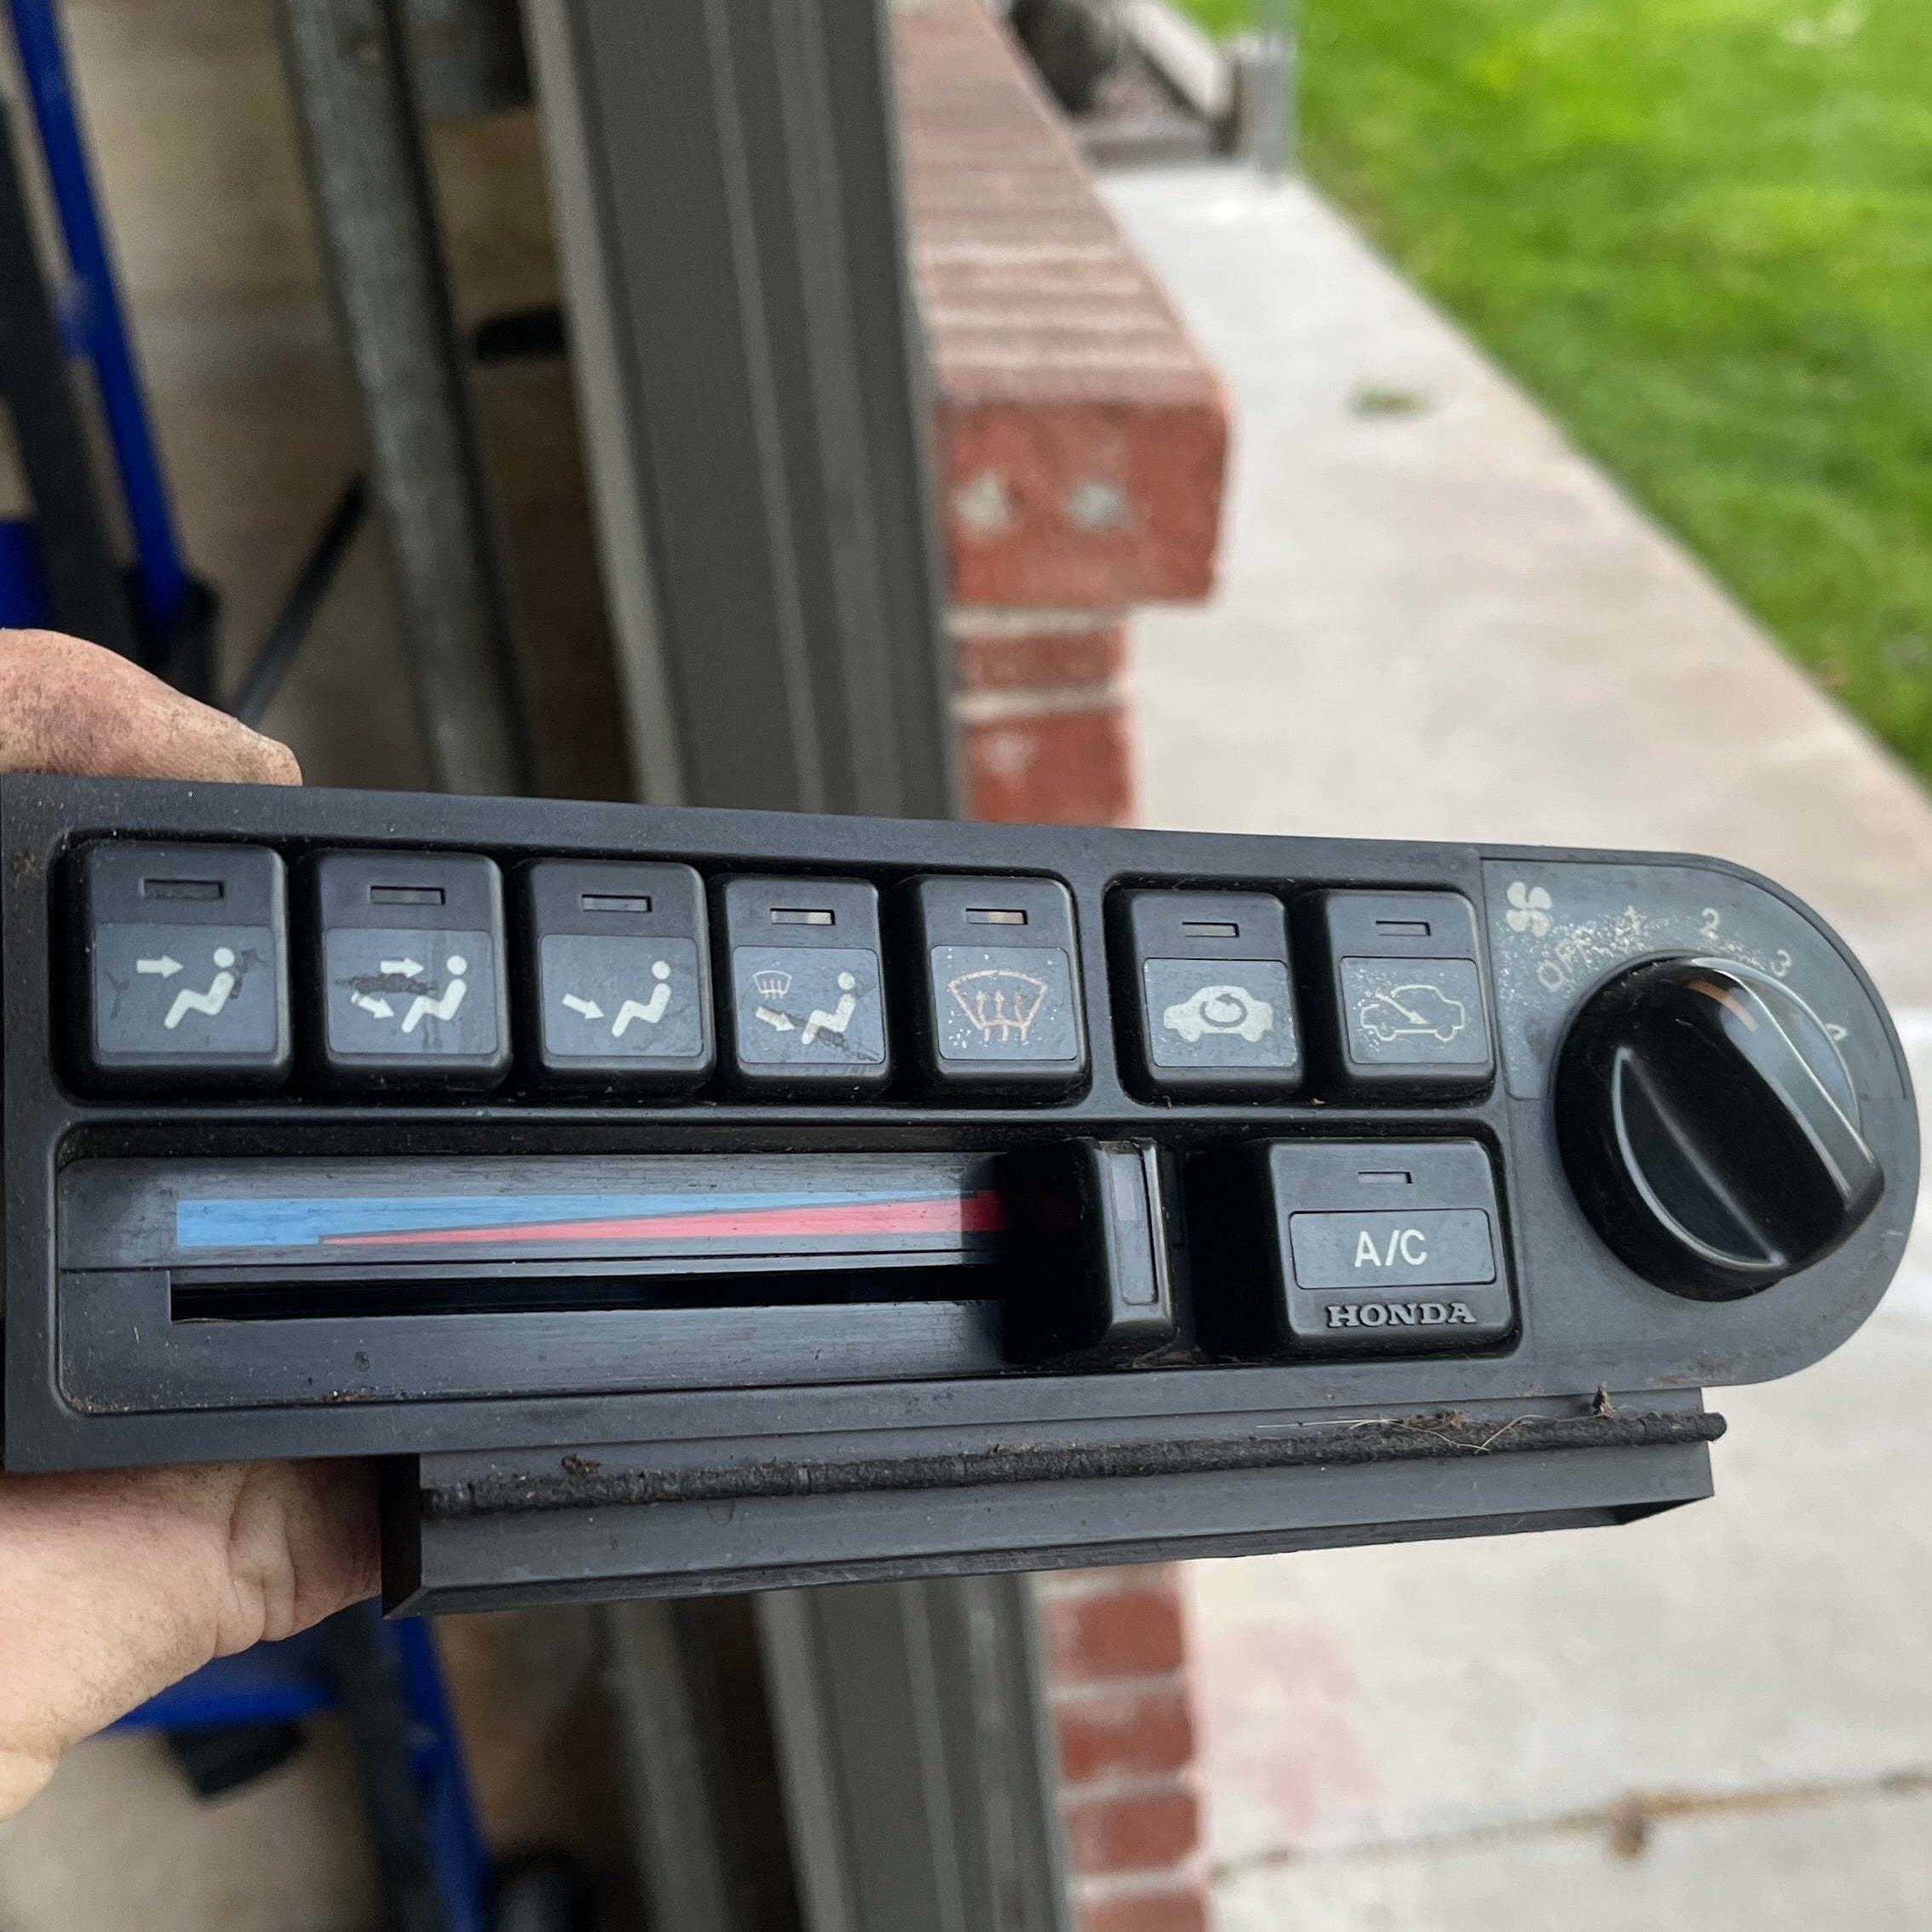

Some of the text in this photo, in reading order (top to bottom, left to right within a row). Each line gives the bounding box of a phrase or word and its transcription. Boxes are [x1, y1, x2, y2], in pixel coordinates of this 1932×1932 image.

[1537, 923, 1596, 992] OFF
[1700, 907, 1720, 940] 2
[1771, 949, 1792, 977] 3
[1354, 1229, 1428, 1268] A/C
[1326, 1302, 1476, 1328] HONDA
